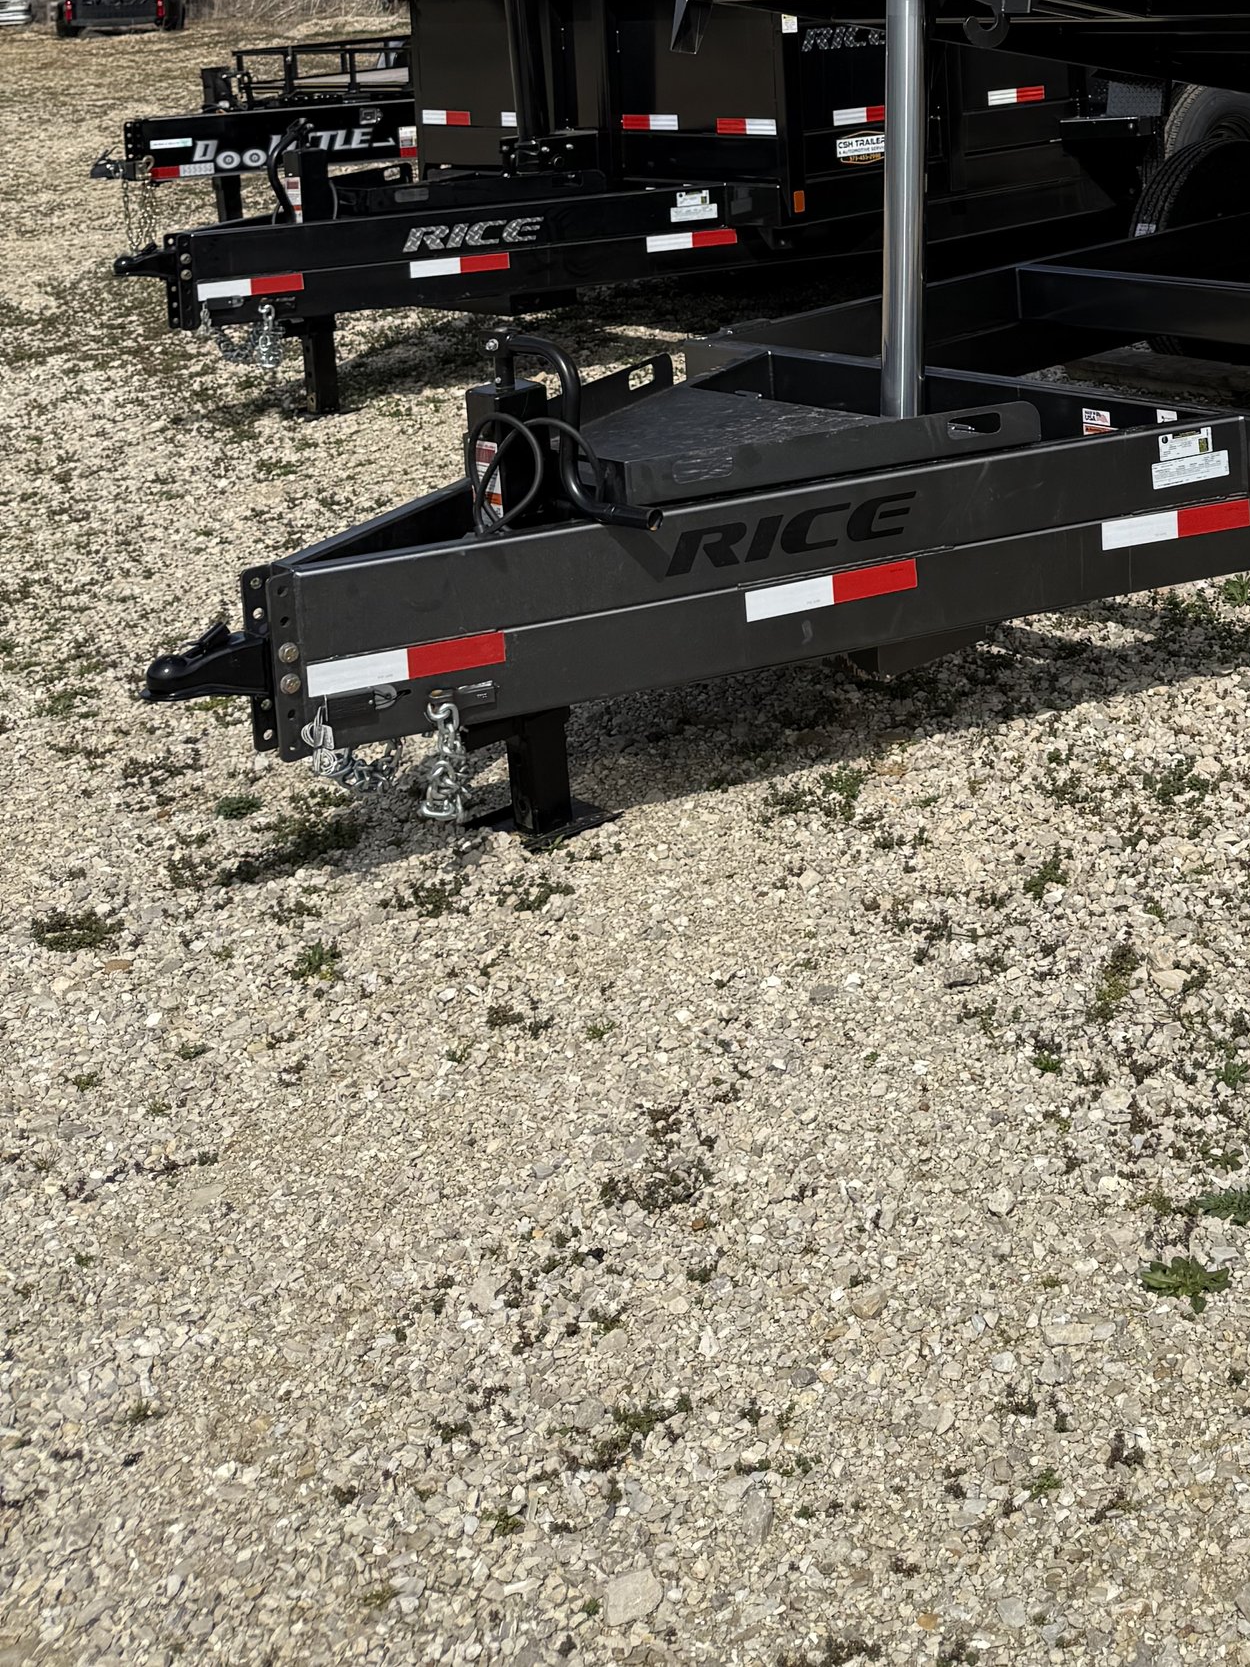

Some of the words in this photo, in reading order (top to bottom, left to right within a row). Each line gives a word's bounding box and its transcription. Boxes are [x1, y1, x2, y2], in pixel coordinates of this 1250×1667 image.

[838, 141, 853, 149] CSH
[855, 137, 885, 147] TRAILER
[402, 216, 545, 253] RICE
[664, 490, 917, 578] RICE
